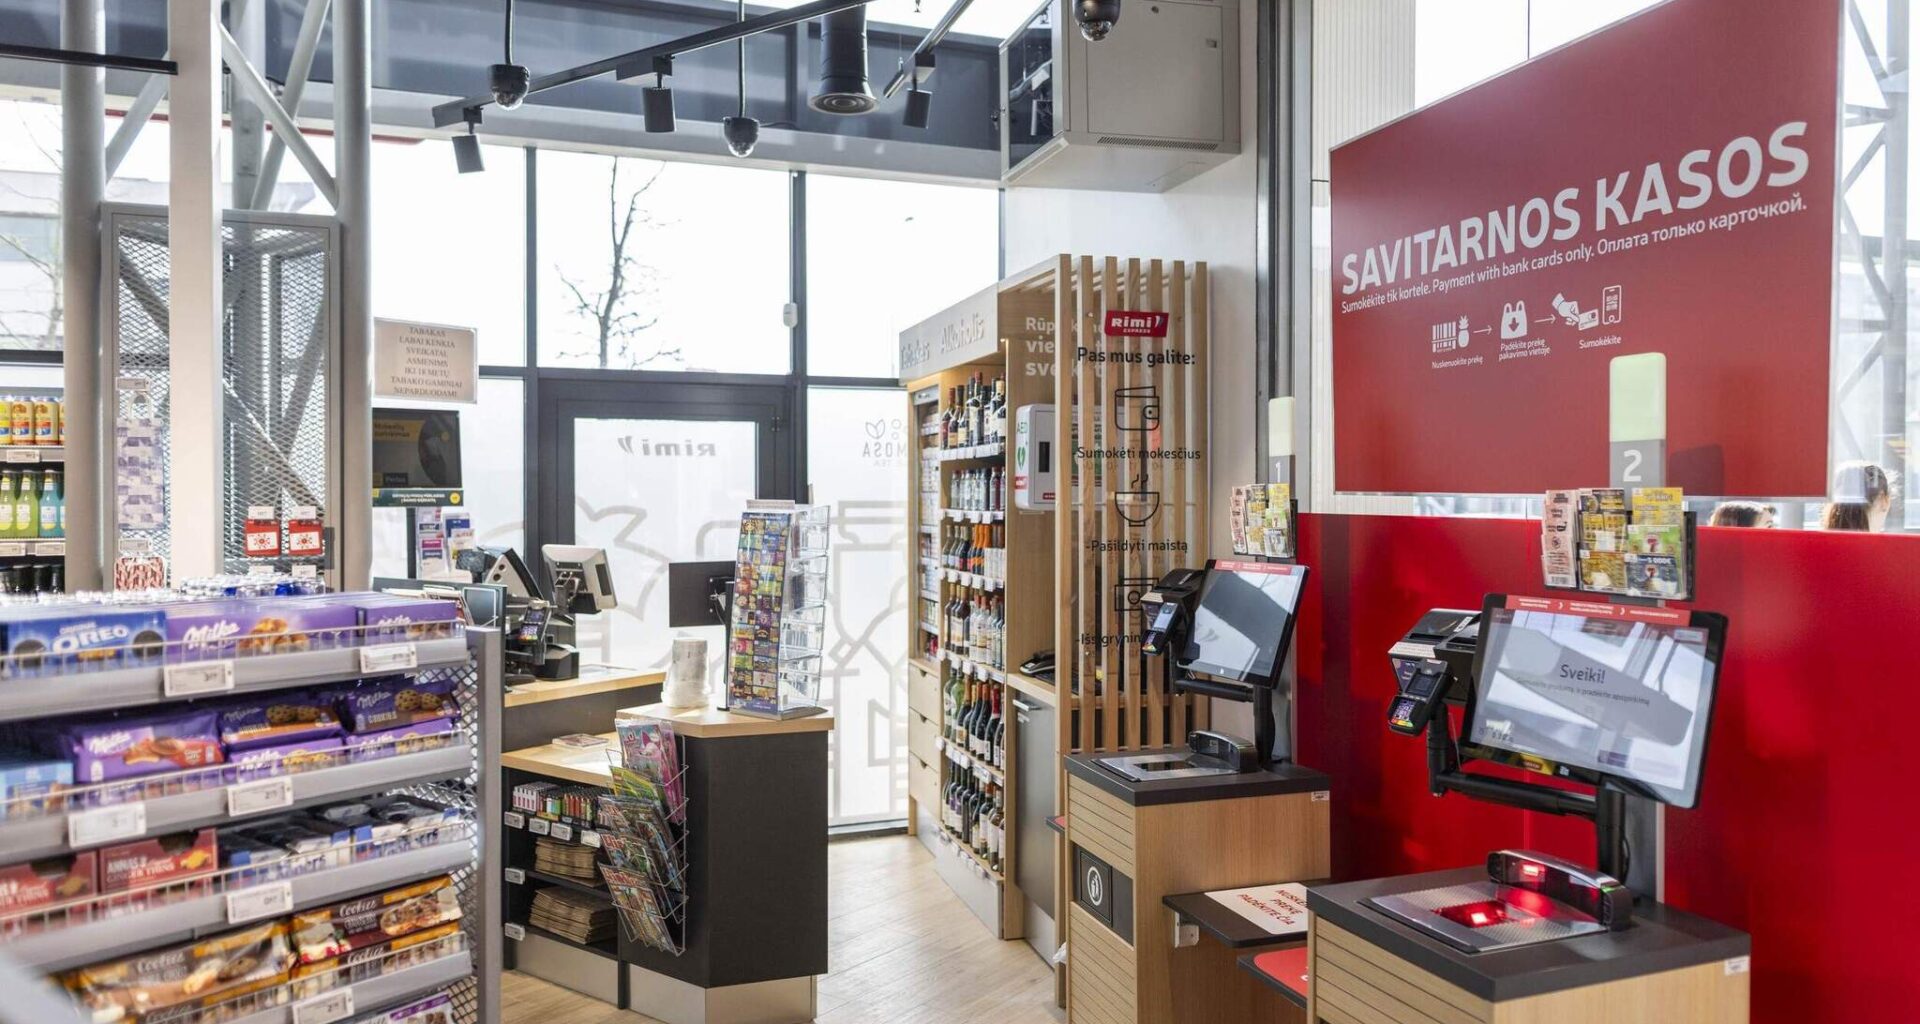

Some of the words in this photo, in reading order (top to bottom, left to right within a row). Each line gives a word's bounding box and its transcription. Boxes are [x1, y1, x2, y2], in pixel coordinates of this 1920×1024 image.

[1341, 188, 1580, 295] SAVITARNOS
[1595, 121, 1809, 231] KASOS
[1341, 291, 1386, 314] Sumokėkite
[1386, 287, 1398, 304] tik
[1399, 281, 1432, 300] kortele.
[1432, 271, 1475, 294] Payment
[1477, 265, 1500, 283] with
[1502, 259, 1529, 277] bank
[1531, 250, 1563, 270] cards
[1565, 243, 1594, 263] only.
[1597, 232, 1649, 256] Оплата
[1652, 220, 1706, 243] только
[1708, 192, 1807, 231] карточкой.
[408, 325, 446, 337] TABAKAS
[1077, 347, 1106, 362] Pas
[1110, 352, 1142, 363] mus
[1147, 349, 1196, 368] galite:
[390, 375, 424, 386] TABAKO
[424, 378, 463, 389] GAMINIAI
[1138, 446, 1201, 459] mokesčius
[1274, 461, 1281, 483] 1
[1622, 449, 1642, 482] 2
[1148, 539, 1188, 554] maistą
[52, 623, 130, 654] OREO
[183, 619, 240, 651] Milka
[1559, 664, 1606, 684] Sveiki!
[356, 690, 392, 709] Milka
[339, 900, 377, 917] Cookies
